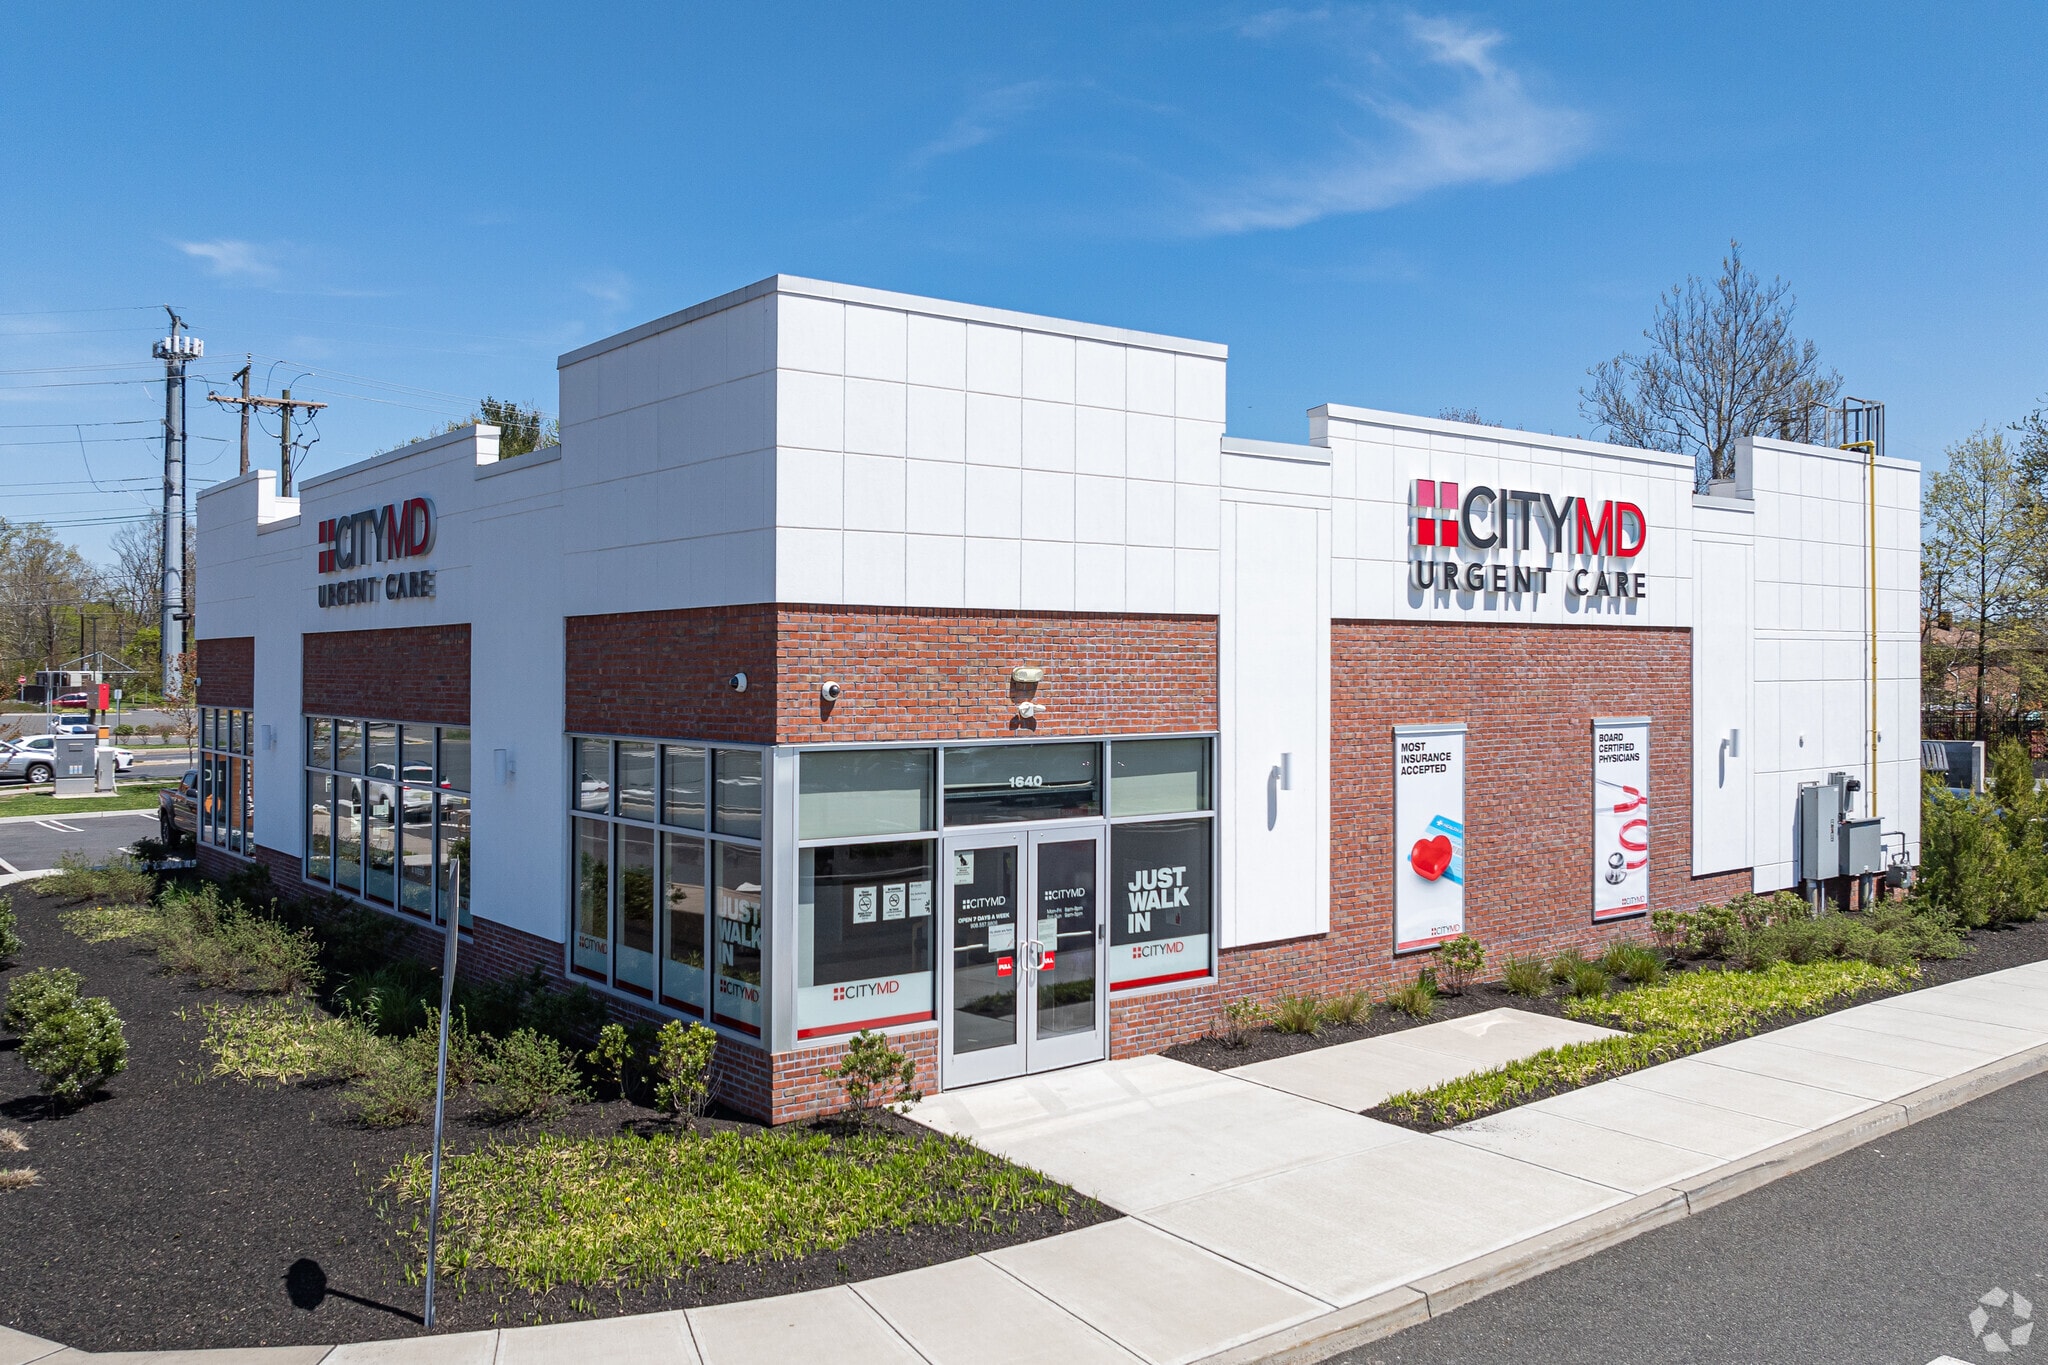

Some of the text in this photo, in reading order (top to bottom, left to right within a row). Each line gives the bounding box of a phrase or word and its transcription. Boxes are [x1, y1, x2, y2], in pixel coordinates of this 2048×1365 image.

[1462, 485, 1647, 558] CITYMD
[335, 497, 432, 570] CITYMD
[1415, 560, 1647, 598] URGENT CARE
[318, 570, 436, 608] URGENT CARE
[1599, 733, 1624, 742] BOARD
[1401, 742, 1426, 752] MOST
[1599, 743, 1635, 753] CERTIFIED
[1401, 752, 1452, 764] INSURANCE
[1599, 753, 1640, 763] PHYSICIANS
[1401, 764, 1447, 775] ACCEPTED
[1009, 775, 1043, 788] 1640
[1128, 866, 1187, 892] JUST
[1051, 887, 1086, 900] CITYMD
[1128, 886, 1190, 912] WALK
[719, 895, 761, 925] JUST
[970, 896, 1006, 909] CITYMD
[958, 916, 973, 924] OPEN
[1128, 911, 1151, 934] IN
[718, 919, 761, 950] WALK
[1436, 923, 1460, 935] CITYMD
[1142, 941, 1184, 958] CITYMD
[998, 963, 1012, 971] PULL
[726, 981, 760, 1003] CITYMD
[845, 980, 900, 999] CITYMD
